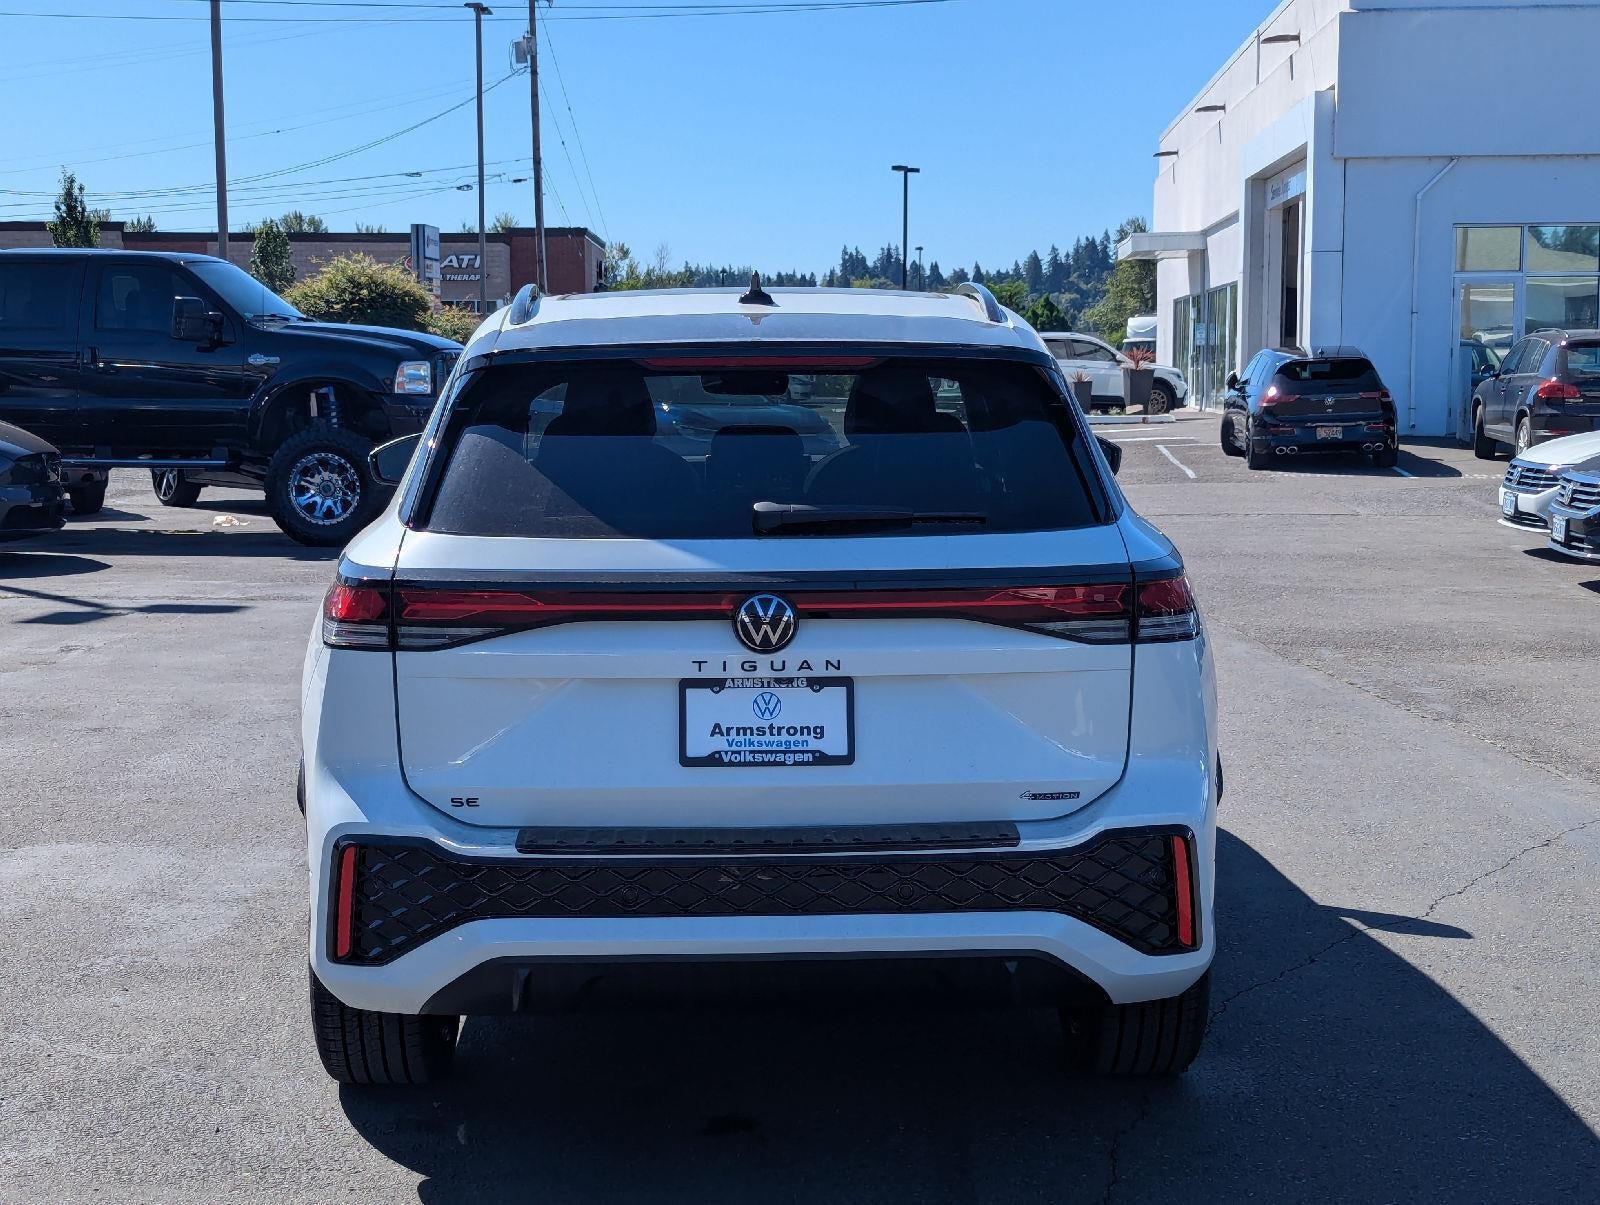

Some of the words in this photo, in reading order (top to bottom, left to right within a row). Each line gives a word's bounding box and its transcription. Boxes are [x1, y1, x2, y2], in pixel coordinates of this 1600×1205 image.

[440, 254, 481, 269] ATI
[692, 660, 841, 672] TIGUAN
[710, 723, 825, 740] Armstrong
[725, 738, 809, 749] Volkswagen
[720, 751, 813, 764] Volkswagen
[450, 797, 480, 807] SE
